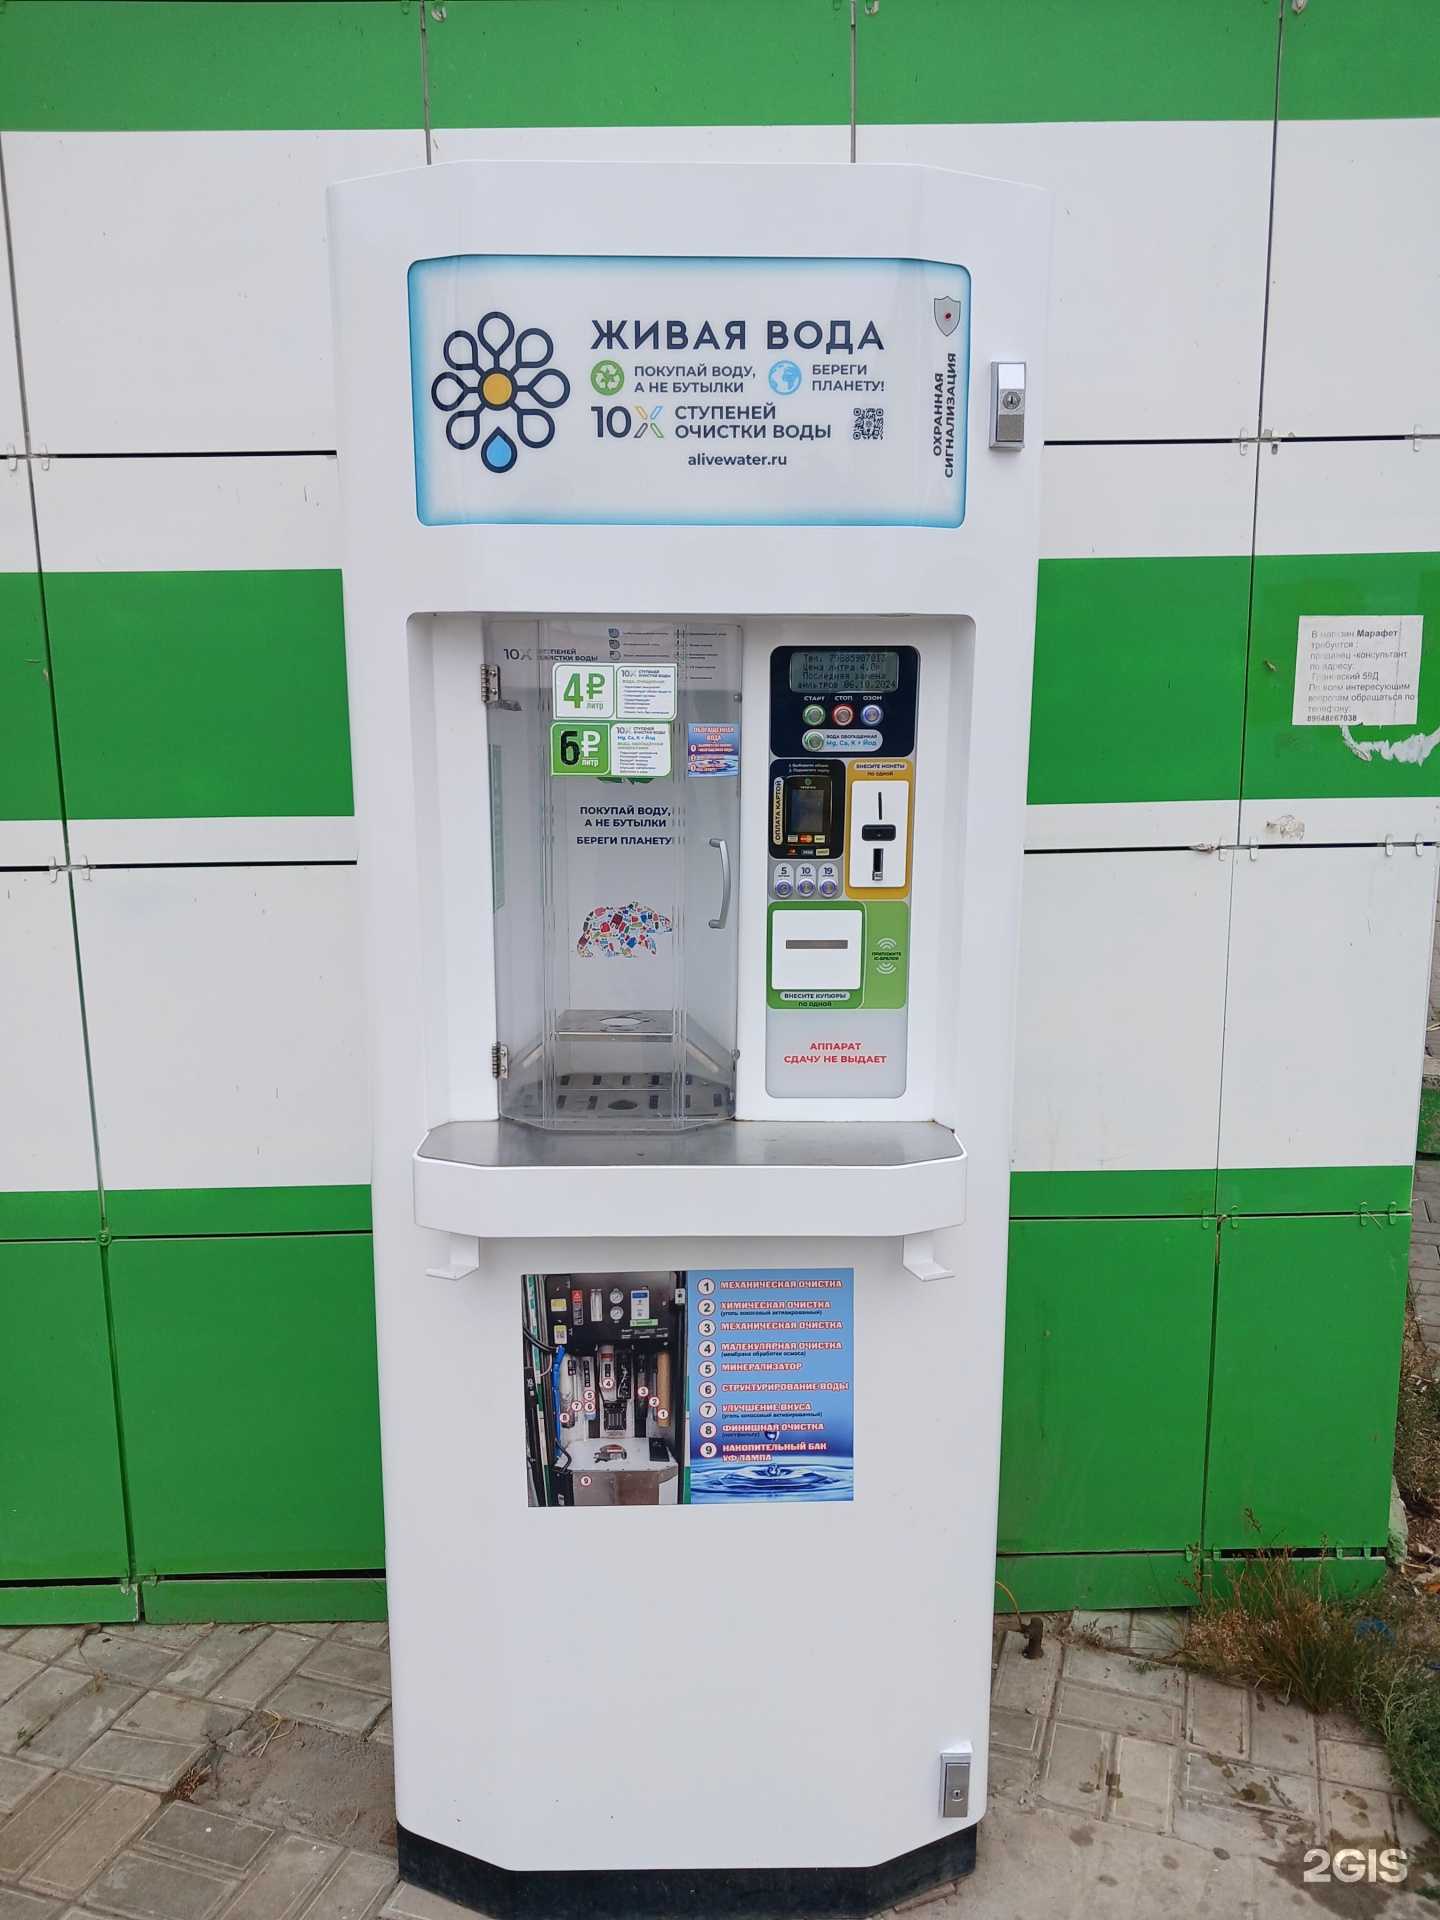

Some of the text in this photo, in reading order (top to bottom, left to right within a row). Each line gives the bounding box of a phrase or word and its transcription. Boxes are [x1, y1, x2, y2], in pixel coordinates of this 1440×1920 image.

[590, 319, 885, 355] ЖИВАЯ ВОДА
[634, 363, 756, 379] ПОКУПАЙ ВОДУ,
[812, 364, 868, 376] БЕРЕГИ
[634, 382, 744, 393] А НЕ БУТЫЛКИ
[812, 380, 885, 392] ПЛАНЕТУ!
[674, 402, 777, 420] СТУПЕНЕЙ
[933, 373, 943, 456] ОХРАННАЯ
[945, 353, 957, 478] СИГНАЛИЗАЦИЯ
[674, 424, 831, 441] ОЧИСТКИ ВОДЫ
[688, 453, 788, 467] alivewater.ru
[1311, 630, 1318, 639] В
[1351, 692, 1403, 703] обращаться
[1404, 693, 1416, 701] по
[581, 759, 599, 768] литр
[579, 805, 671, 817] ПОКУПАЙ ВОДУ,
[584, 819, 667, 828] А НЕ БУТЫЛКИ
[576, 836, 618, 845] БЕРЕГИ
[781, 866, 788, 875] 5
[801, 866, 811, 875] 10
[823, 867, 833, 875] 19
[808, 1000, 832, 1008] ОДНОЙ
[810, 1042, 862, 1051] АППАРАТ
[783, 1055, 888, 1065] СДАЧУ НЕ ВЫДАЕТ
[703, 1279, 843, 1292] 1 МЕХАНИЧЕСКАЯ ОЧИСТКА
[703, 1300, 832, 1313] 2 ХИМИЧЕСКАЯ ОЧИСТКА
[704, 1320, 843, 1333] 3 МЕХАНИЧЕСКАЯ ОЧИСТКА
[703, 1344, 711, 1353] 4
[798, 1341, 843, 1350] ОЧИСТКА
[704, 1362, 802, 1374] 5 МИНЕРАЛИЗАТОР
[704, 1381, 849, 1394] 6 СТРУКТУРИРОВАНИЕ ВОДЫ
[704, 1402, 812, 1415] 7 УЛУЧШЕНИЕ ВКУСА
[705, 1425, 712, 1435] 8
[722, 1423, 780, 1432] ФИНИШНАЯ
[781, 1422, 825, 1431] ОЧИСТКА
[705, 1441, 827, 1455] 9 НАКОПИТЕЛЬНЫЙ БАК
